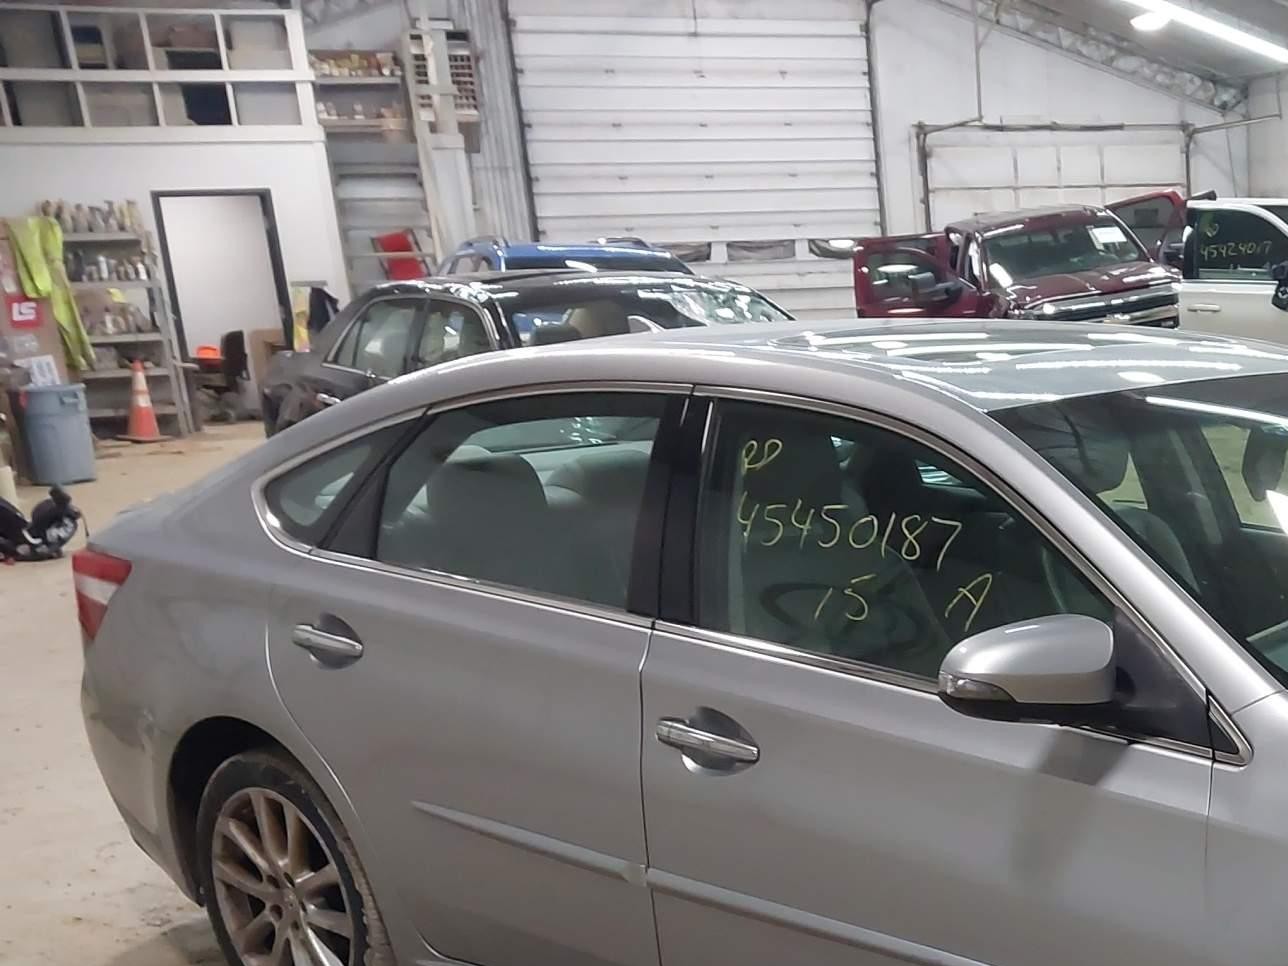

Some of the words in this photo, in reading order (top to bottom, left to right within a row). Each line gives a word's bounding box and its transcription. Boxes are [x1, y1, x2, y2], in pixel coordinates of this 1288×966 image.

[1200, 241, 1272, 260] 45424017
[736, 491, 963, 572] 45450187
[814, 573, 877, 621] 15
[944, 573, 994, 632] A
